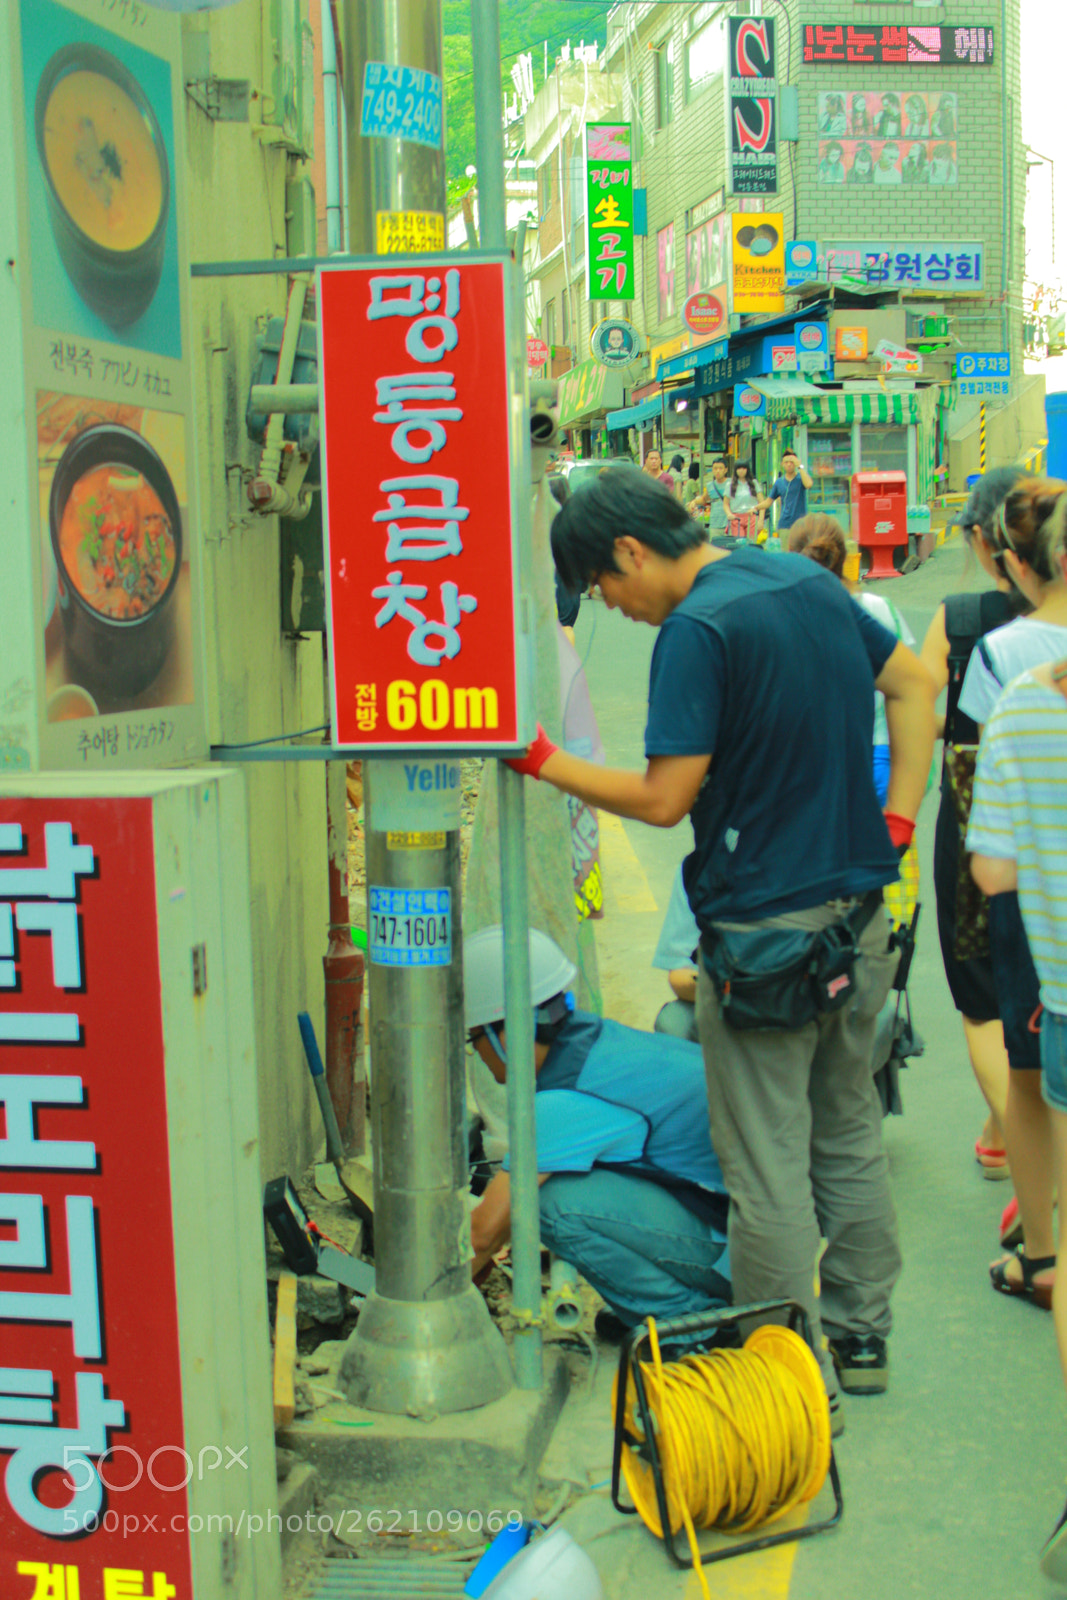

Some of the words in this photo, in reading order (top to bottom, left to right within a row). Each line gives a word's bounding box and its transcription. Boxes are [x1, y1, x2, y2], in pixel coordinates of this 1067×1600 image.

[365, 89, 441, 134] 749-2400
[733, 153, 776, 165] HAIR
[590, 168, 630, 189] 진미
[734, 264, 782, 276] Kitchen
[864, 252, 981, 282] 강원상회
[691, 305, 718, 316] Isaac
[802, 331, 820, 342] 담배
[977, 357, 1008, 372] 주차장
[741, 393, 760, 404] 담배
[366, 268, 478, 667] 명동곱창
[355, 683, 378, 731] 전방
[386, 679, 499, 731] 60m
[373, 915, 449, 946] 747-1604
